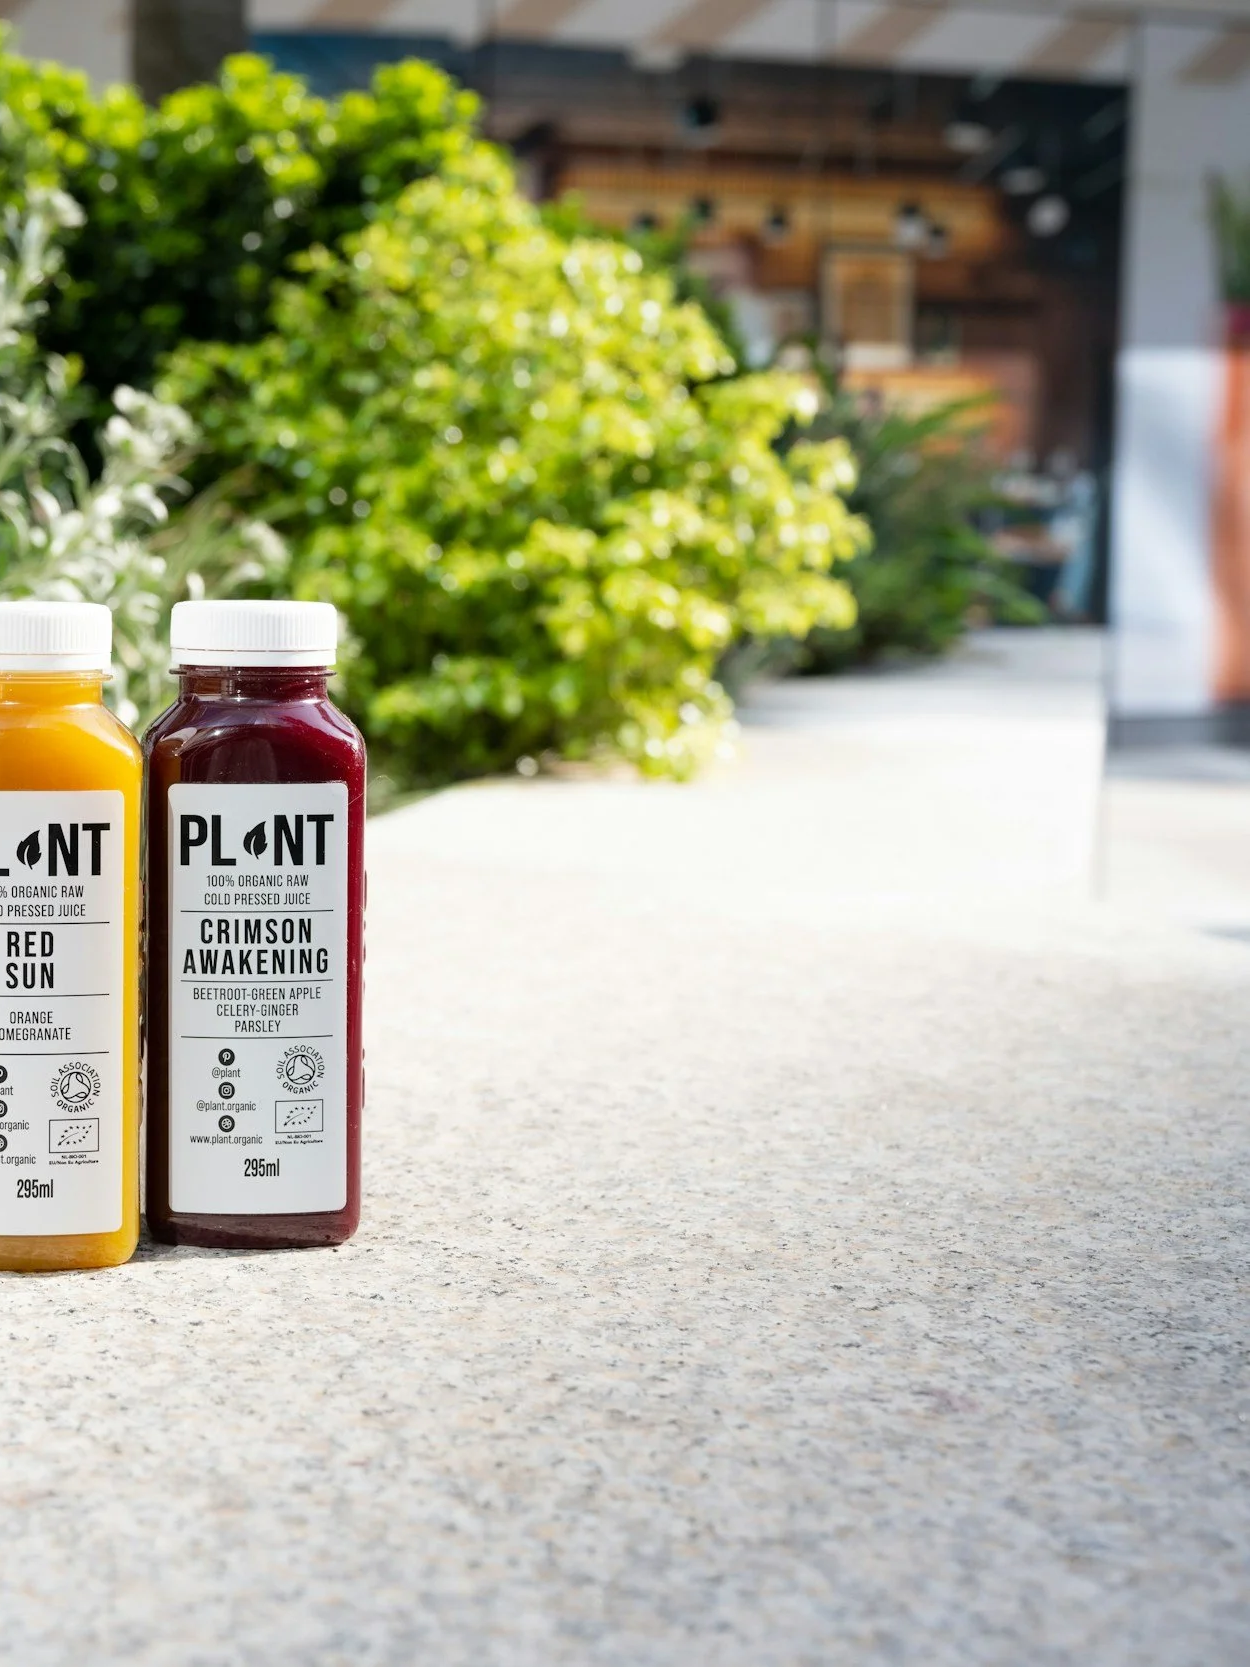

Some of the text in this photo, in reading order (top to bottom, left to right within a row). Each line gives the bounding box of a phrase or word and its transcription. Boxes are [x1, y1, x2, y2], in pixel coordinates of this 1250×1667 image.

[207, 875, 309, 887] 100% ORGANIC RAW
[11, 886, 58, 898] ORGANIC
[61, 885, 84, 897] RAW
[204, 893, 311, 905] COLD PRESSED JUICE
[8, 905, 54, 916] PRESSED
[58, 904, 86, 916] JUICE
[201, 918, 312, 944] CRIMSON
[7, 932, 54, 957] RED
[183, 949, 328, 974] AWAKENING
[6, 962, 54, 988] SUN
[193, 987, 321, 1000] BEETROOT-GREEN APPLE
[216, 1004, 299, 1016] CELERY-GINGER
[9, 1012, 53, 1024] ORANGE
[235, 1020, 281, 1032] PARSLEY
[276, 1044, 325, 1080] SOIL ASSOCIATION
[50, 1062, 101, 1098] SOIL ASSOCIATION
[212, 1068, 240, 1079] @plant
[282, 1080, 318, 1094] ORGANIC
[56, 1098, 94, 1112] ORGANIC
[196, 1101, 256, 1113] @plant.organic
[190, 1134, 263, 1146] www.plant.organic
[244, 1158, 280, 1177] 295ml
[17, 1179, 54, 1198] 295ml
